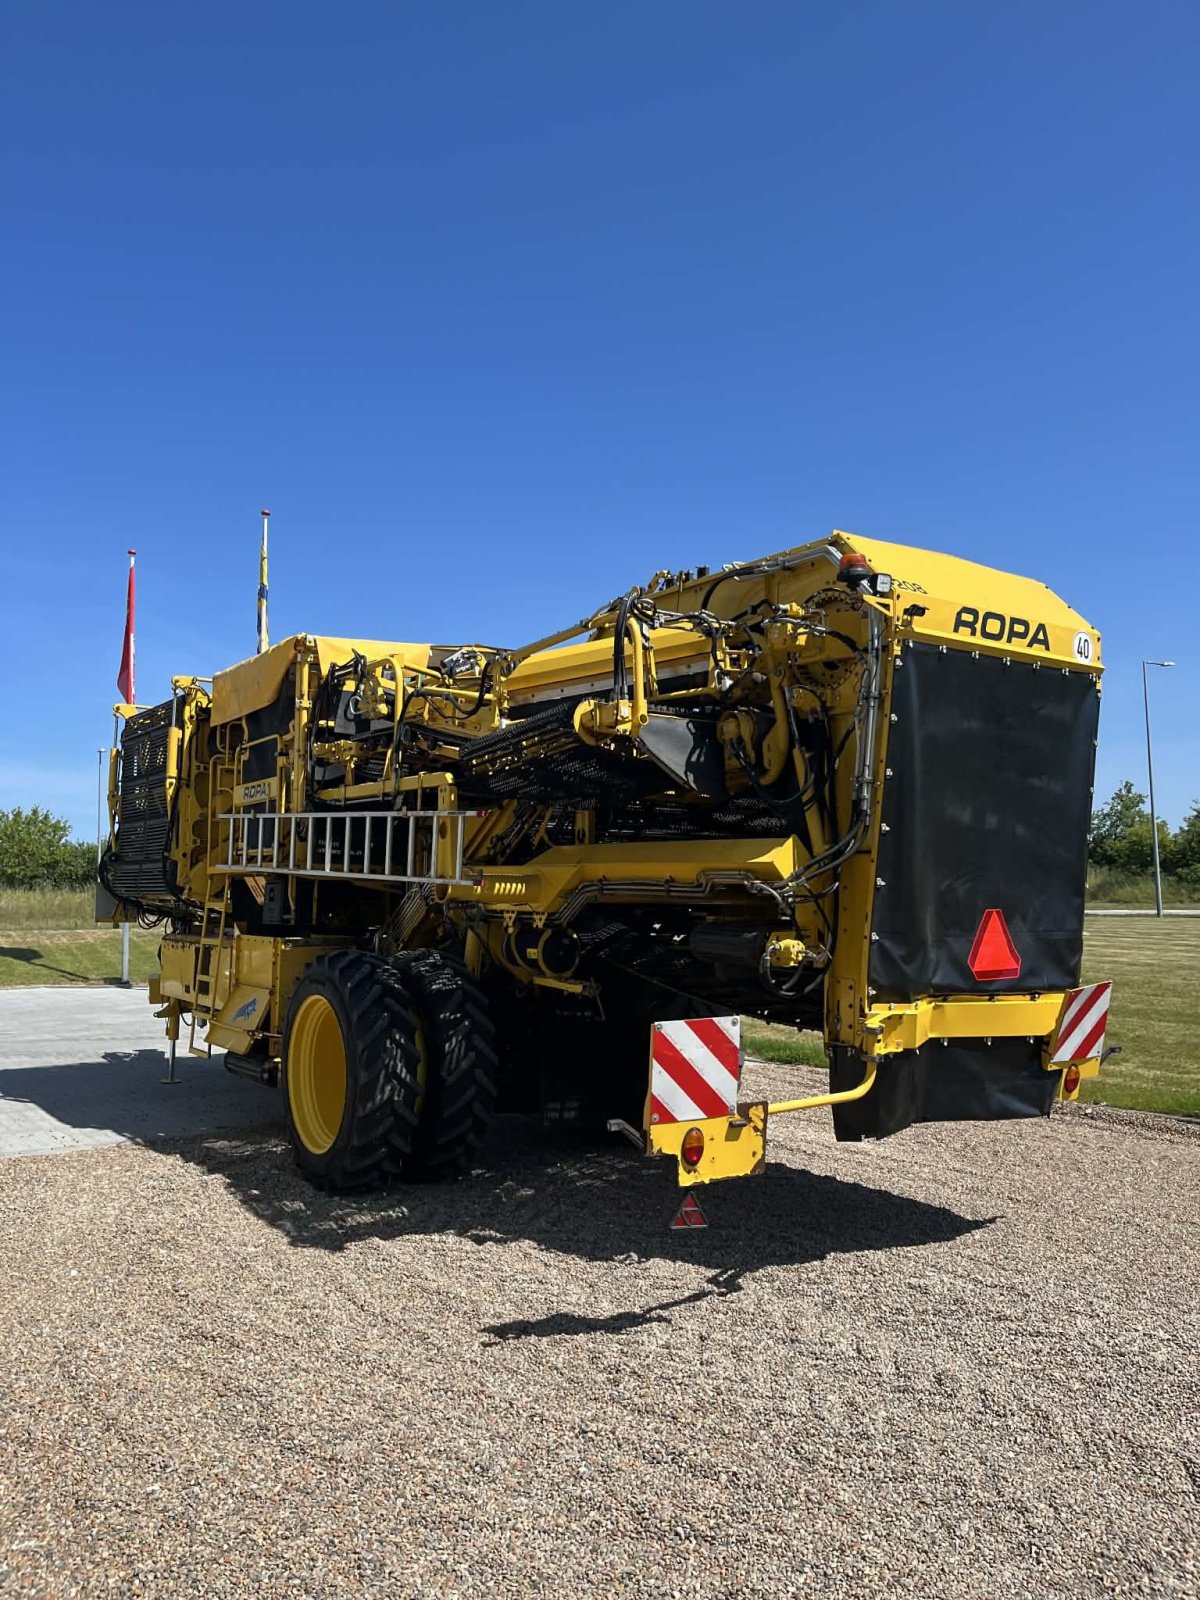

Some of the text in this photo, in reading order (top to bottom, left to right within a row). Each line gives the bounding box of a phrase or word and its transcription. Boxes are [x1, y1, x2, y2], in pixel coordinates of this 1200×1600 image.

[953, 606, 1051, 651] ROPA
[1076, 636, 1090, 659] 40
[243, 783, 268, 799] ROPA
